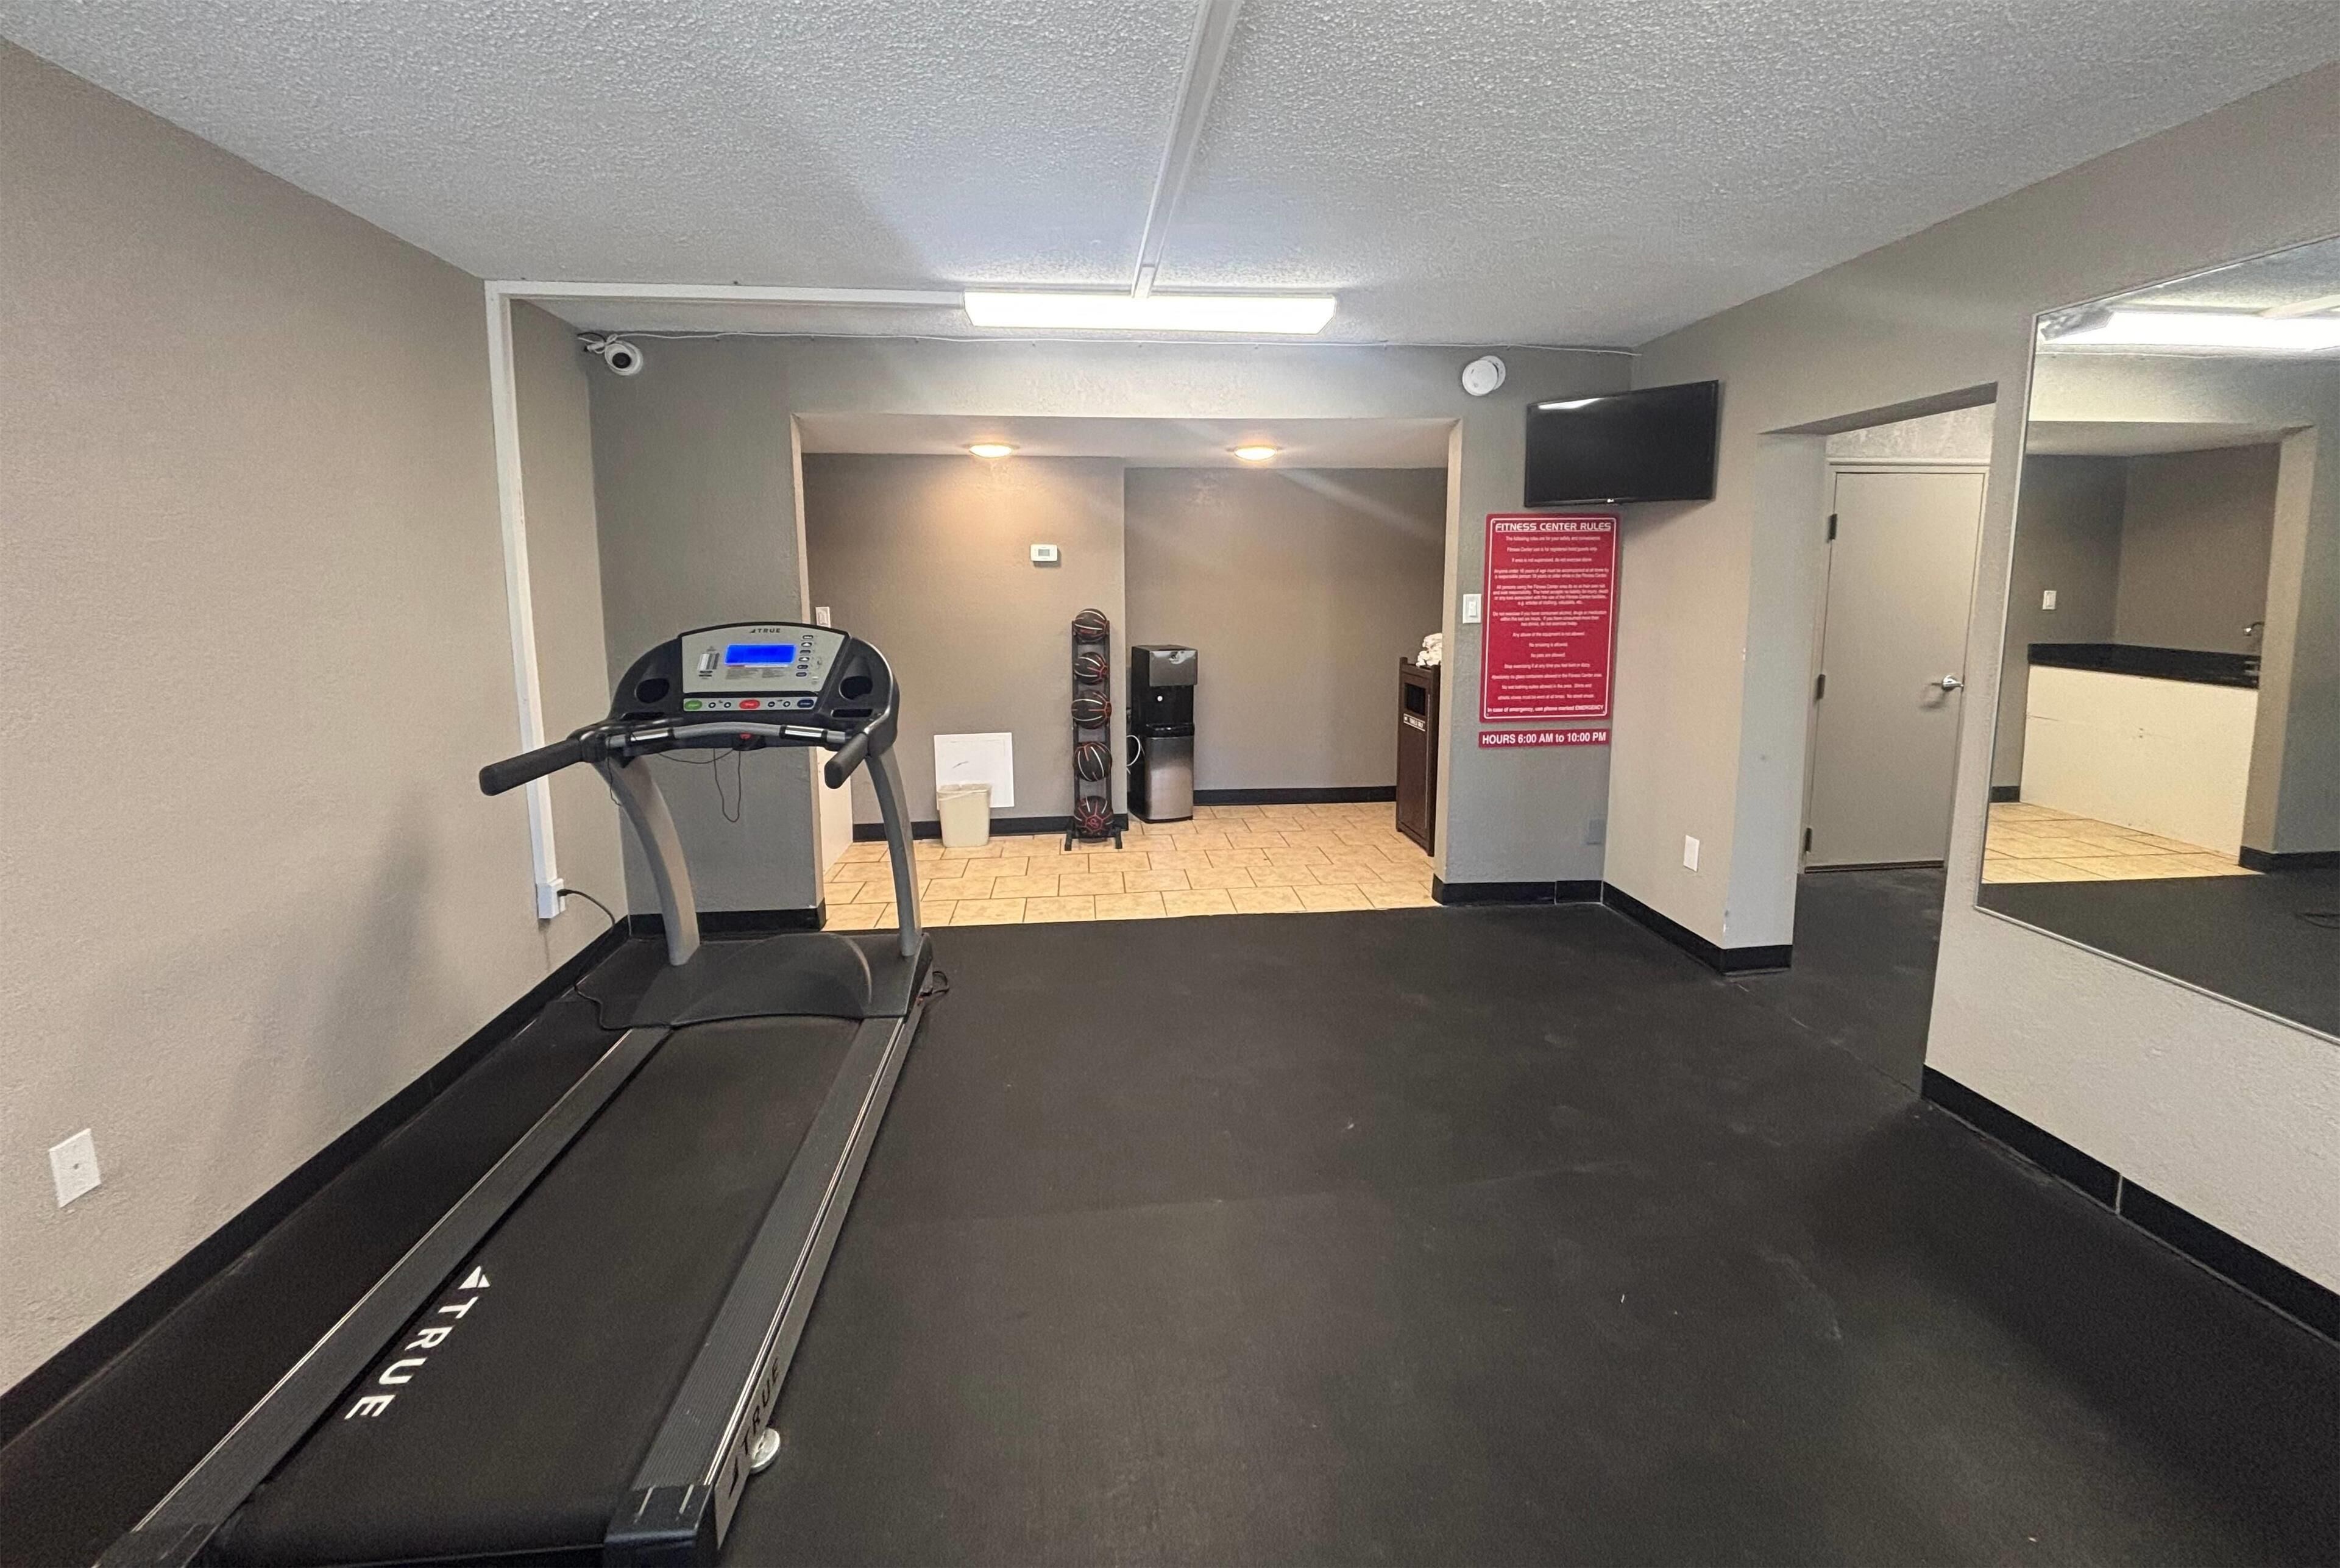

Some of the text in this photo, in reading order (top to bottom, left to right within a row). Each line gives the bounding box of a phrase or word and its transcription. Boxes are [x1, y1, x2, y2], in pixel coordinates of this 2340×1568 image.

[1483, 732, 1606, 744] HOURS 6:00 AM to 10:00 PM
[344, 1296, 478, 1419] TRUE
[741, 1358, 779, 1455] TRUE
